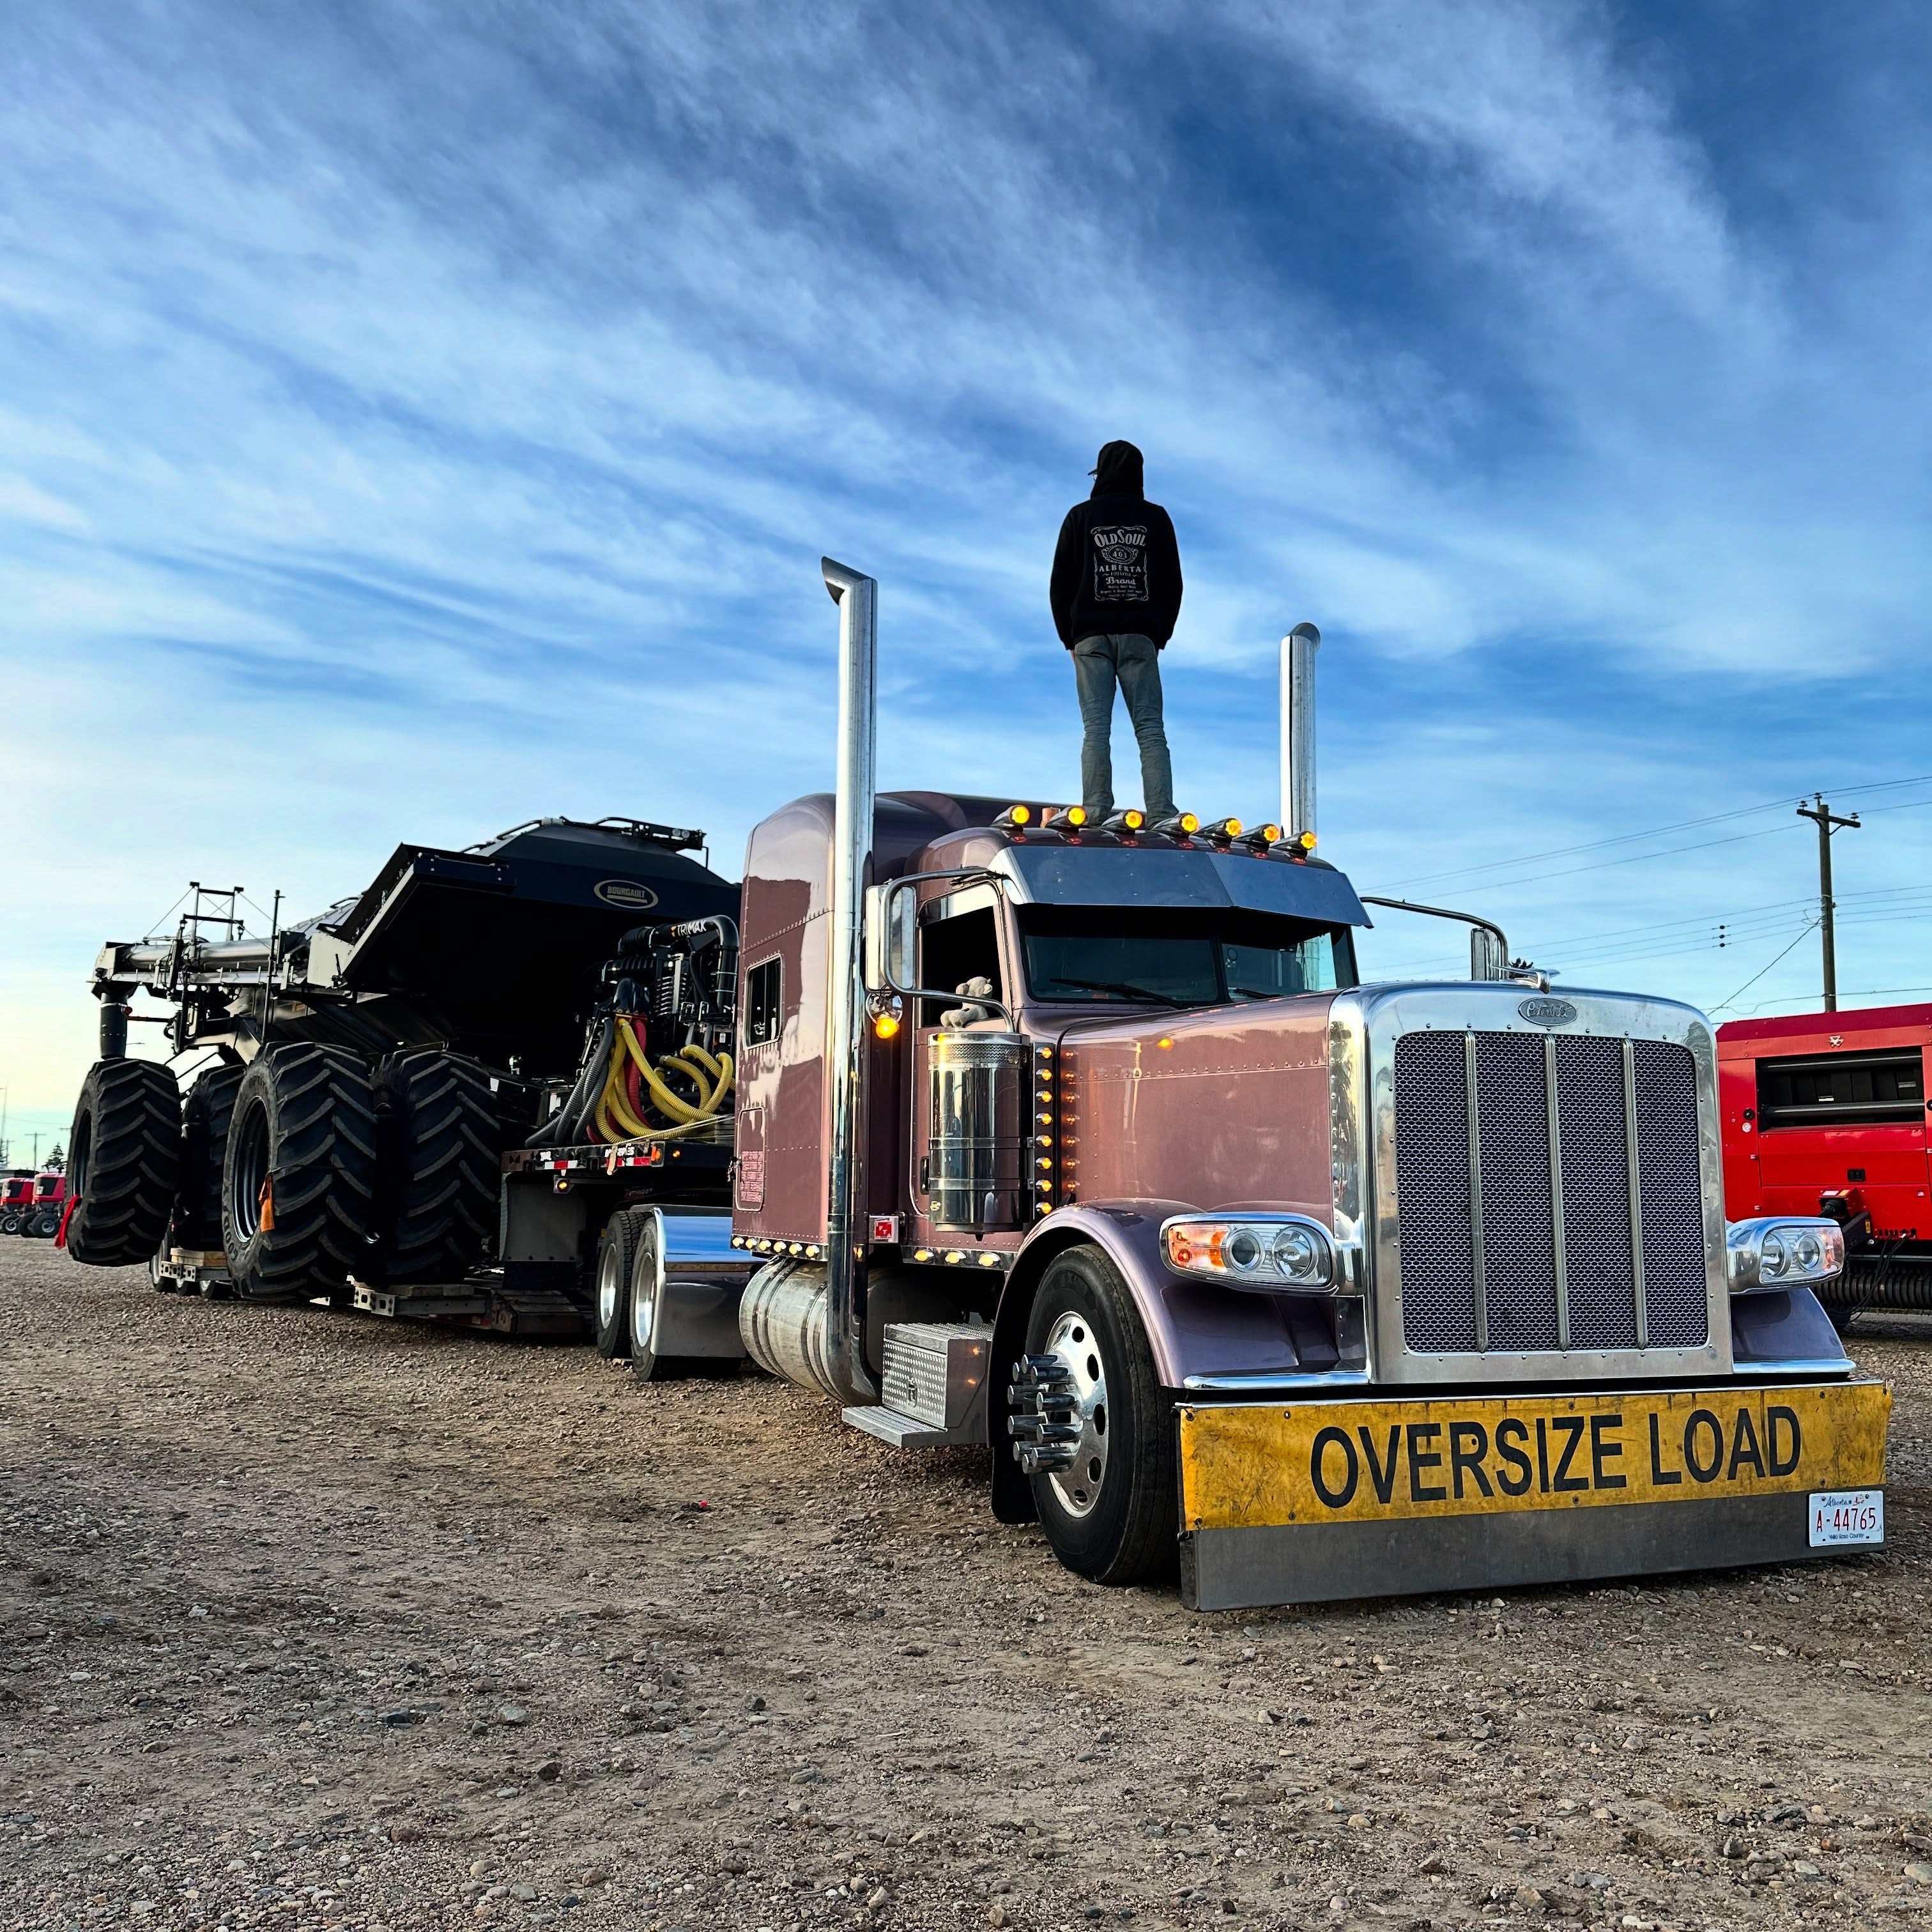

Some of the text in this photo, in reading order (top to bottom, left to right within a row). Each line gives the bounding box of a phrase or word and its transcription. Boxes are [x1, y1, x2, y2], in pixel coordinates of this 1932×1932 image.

[1099, 564, 1142, 572] ALBERTA
[1105, 576, 1136, 585] Brand
[607, 885, 645, 898] BOURGAULT
[677, 919, 707, 937] TRIMAX
[1310, 1406, 1801, 1509] OVERSIZE LOAD
[1816, 1507, 1876, 1533] A-44765
